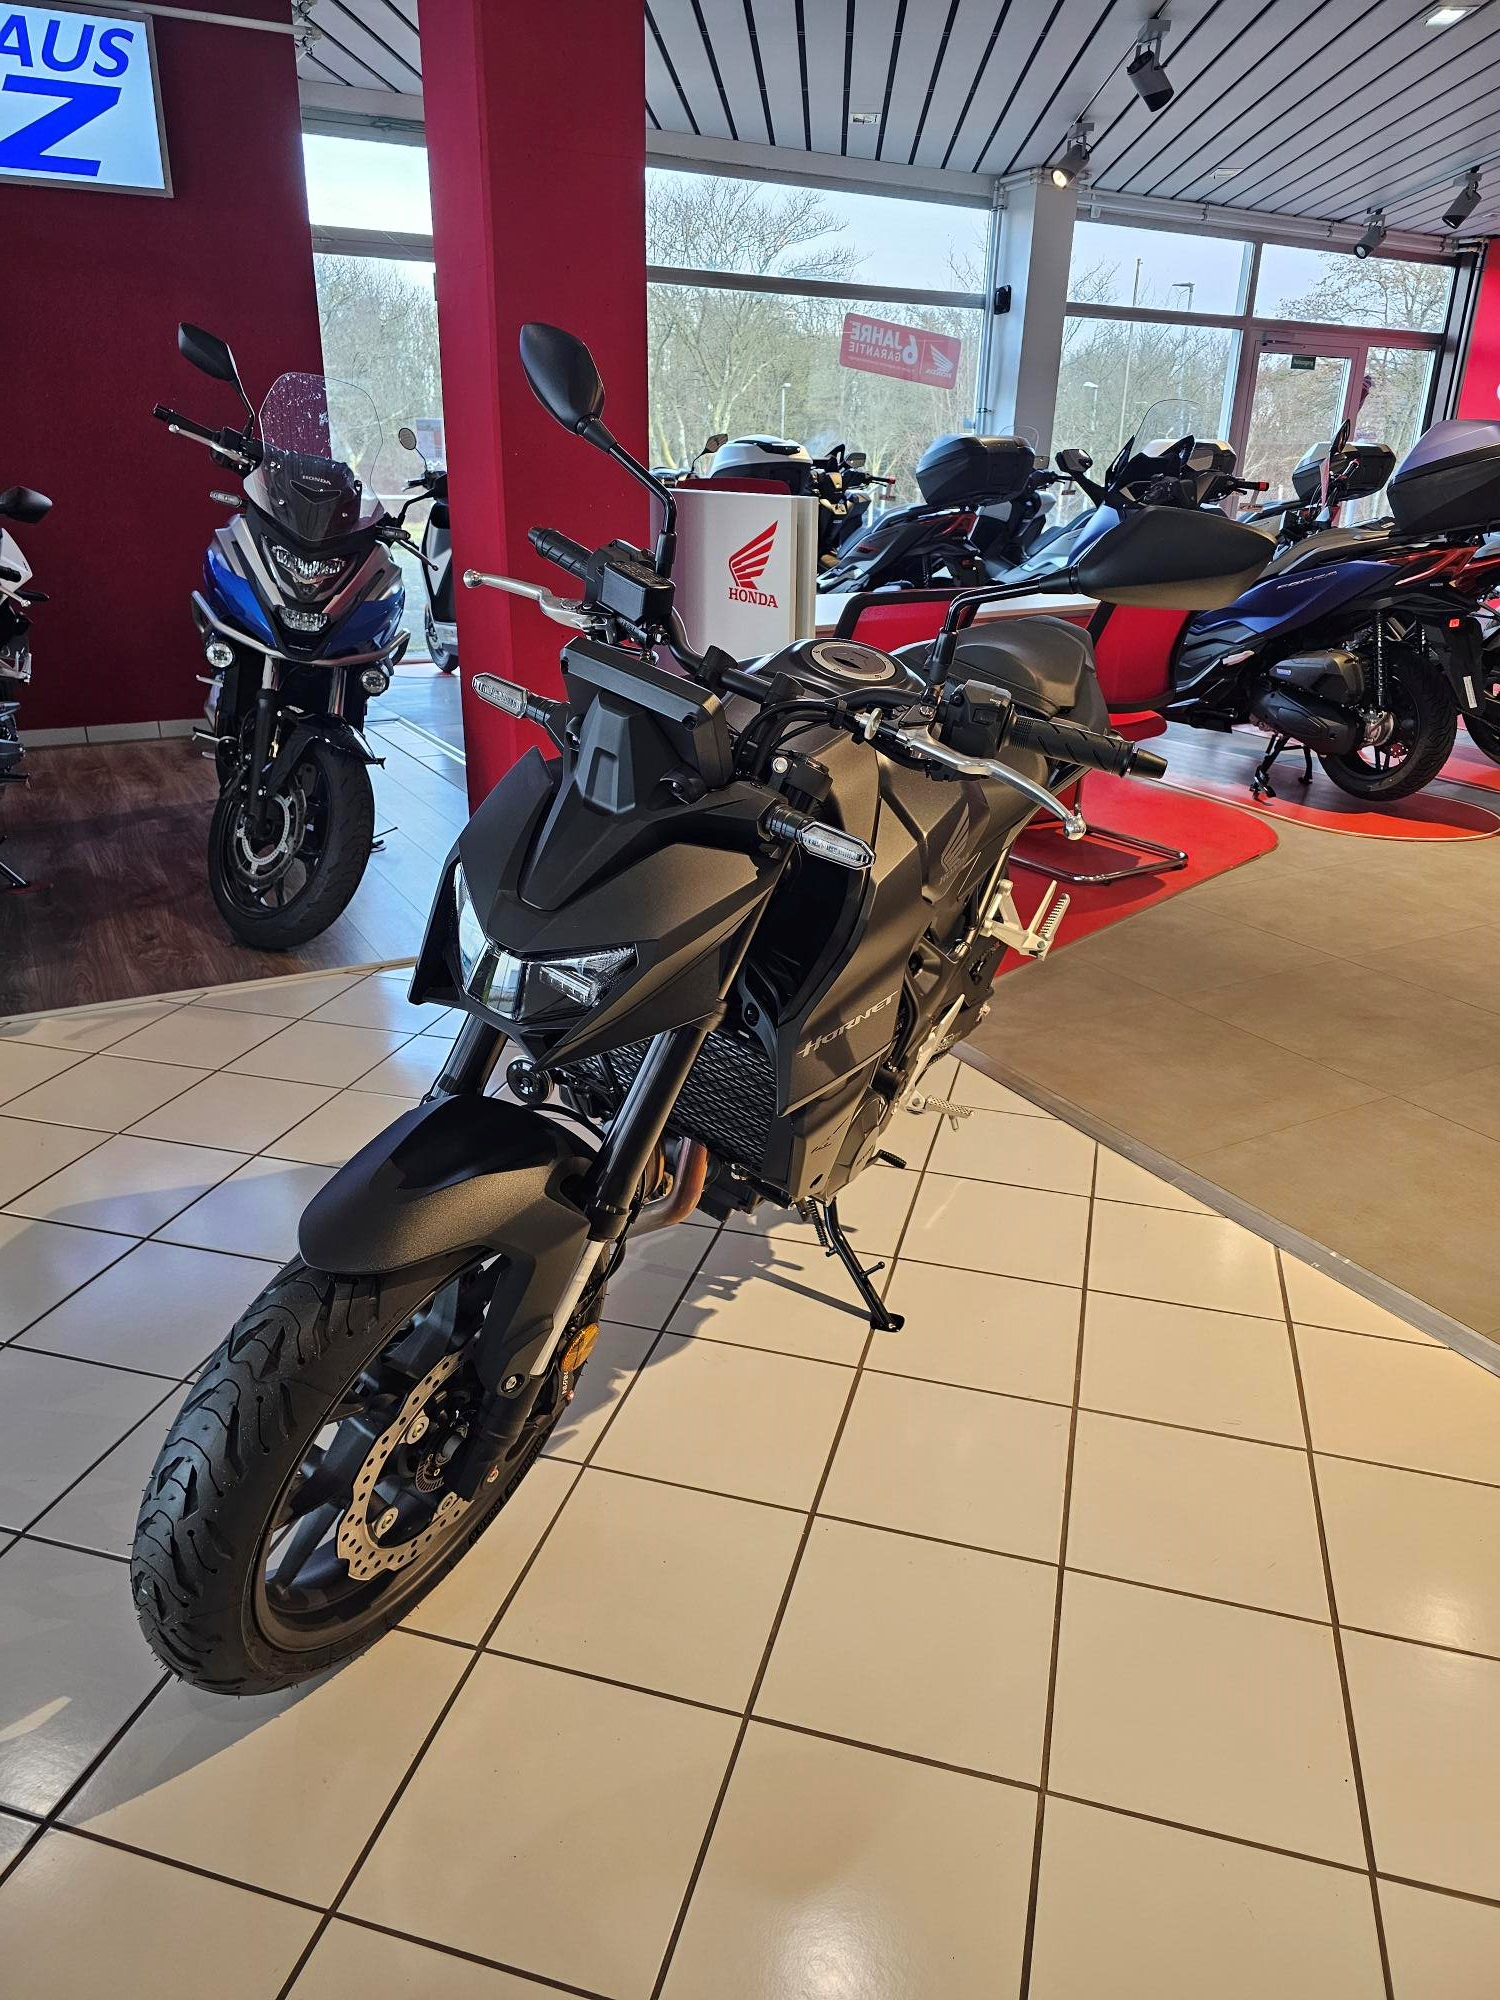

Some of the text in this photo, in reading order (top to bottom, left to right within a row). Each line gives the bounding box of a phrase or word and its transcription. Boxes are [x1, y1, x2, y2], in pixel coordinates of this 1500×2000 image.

[0, 14, 135, 78] AUS
[302, 475, 332, 486] HONDA
[728, 587, 779, 609] HONDA
[797, 990, 899, 1058] HORNET
